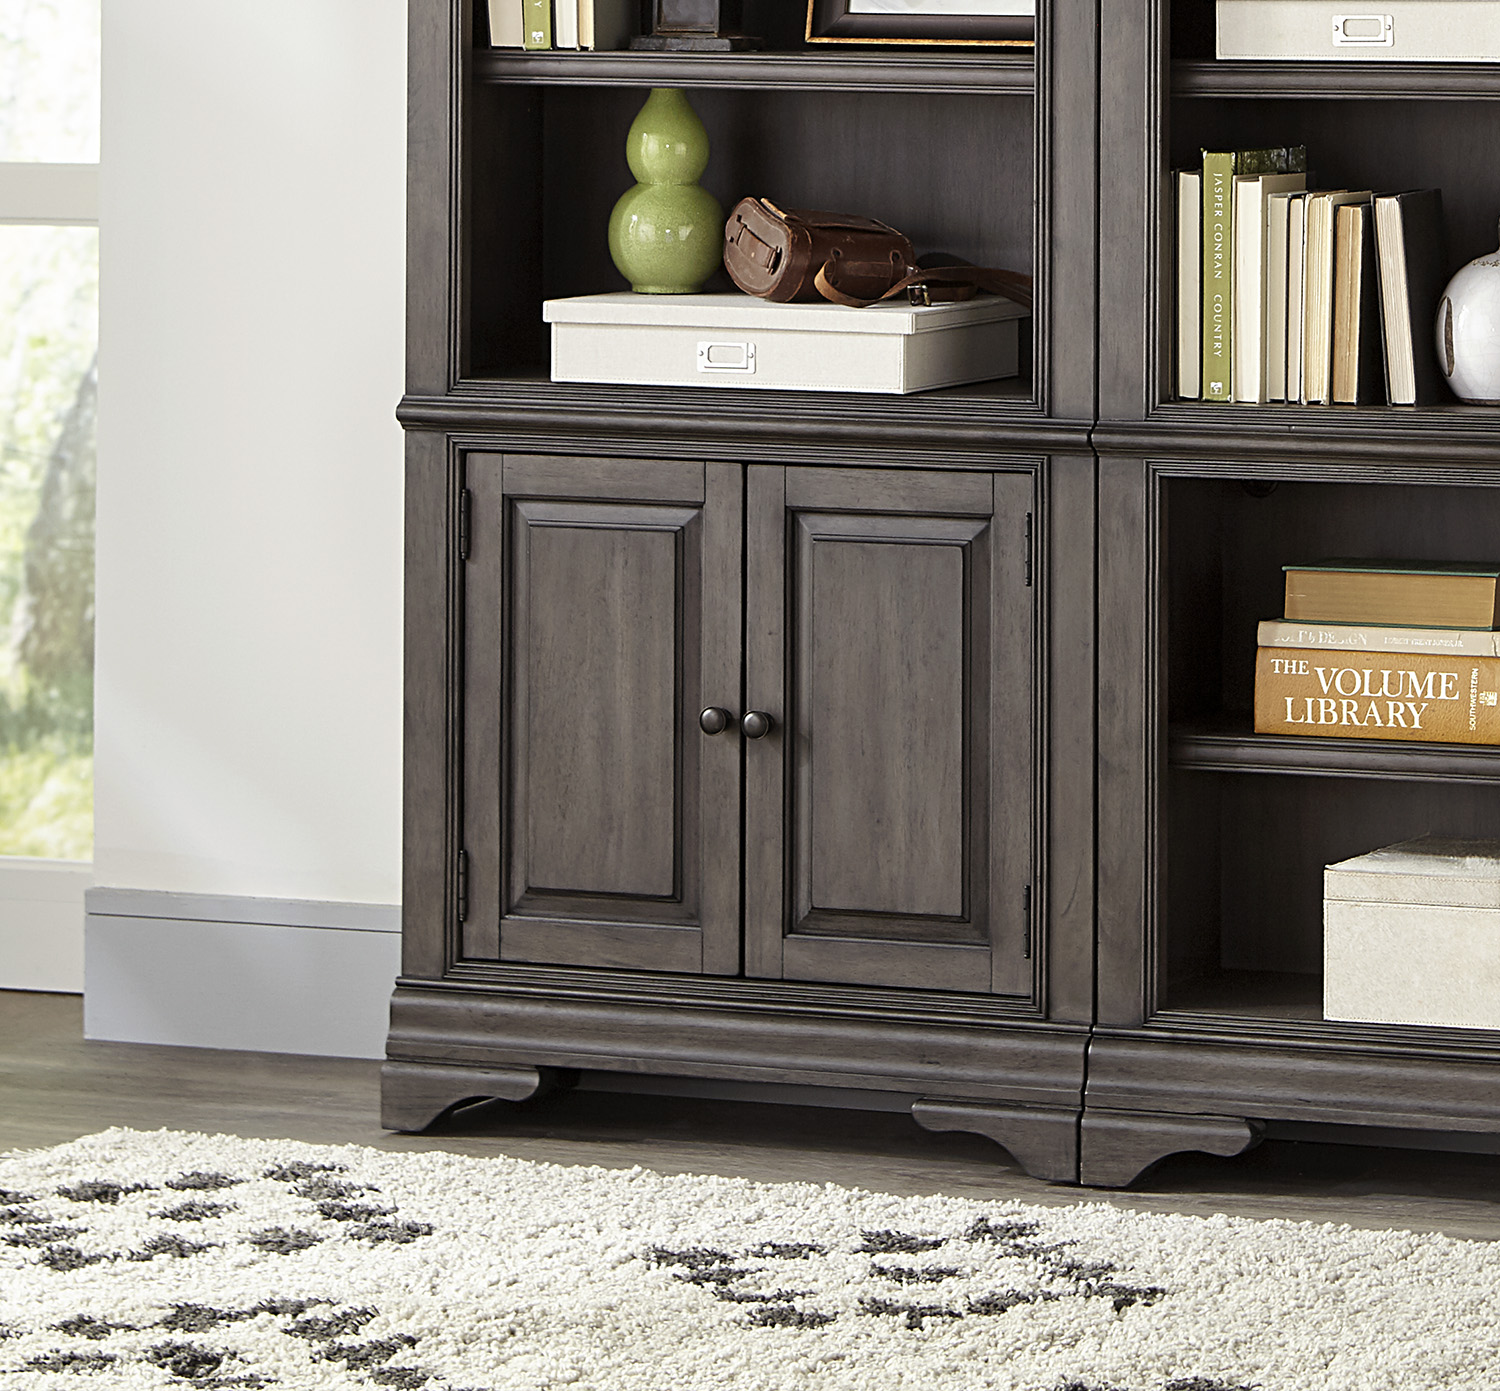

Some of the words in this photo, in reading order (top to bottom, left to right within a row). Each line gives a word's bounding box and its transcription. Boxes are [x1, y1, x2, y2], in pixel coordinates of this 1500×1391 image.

[1213, 173, 1223, 217] JASPER
[1213, 223, 1223, 279] CONRAN
[1213, 294, 1223, 358] COUNTRY
[1270, 659, 1309, 675] THE
[1314, 667, 1460, 700] VOLUME
[1469, 668, 1479, 731] SOUTHWESTERN
[1284, 697, 1429, 729] LIBRARY
